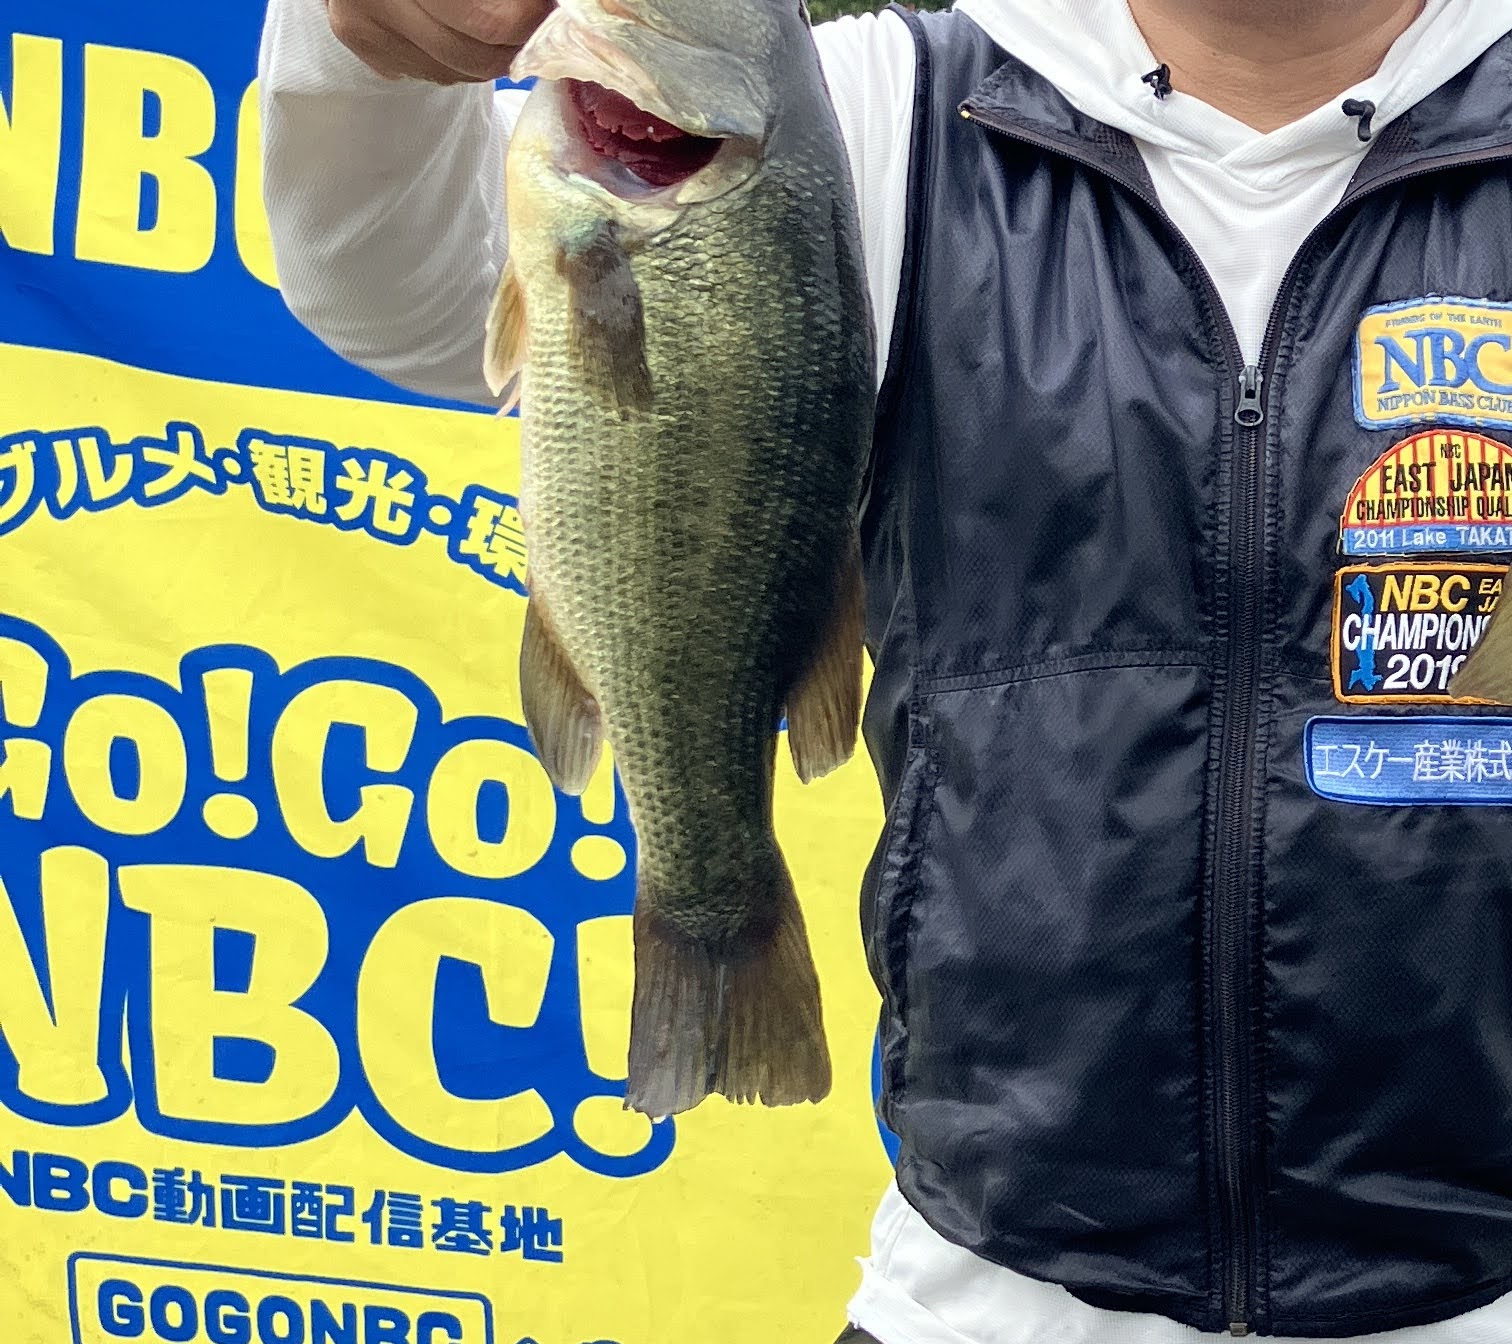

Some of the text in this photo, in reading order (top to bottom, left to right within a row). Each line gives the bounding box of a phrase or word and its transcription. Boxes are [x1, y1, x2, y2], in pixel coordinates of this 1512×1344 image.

[1447, 312, 1467, 323] THE
[1377, 389, 1437, 412] NIPPON
[1438, 390, 1475, 410] BASS
[1440, 442, 1462, 459] NBC
[1382, 461, 1437, 494] EAST
[1356, 495, 1469, 521] CHAMPIONSHIP
[1353, 530, 1396, 549] 2011
[1401, 529, 1448, 546] Lake
[1379, 574, 1503, 613] NBC EA
